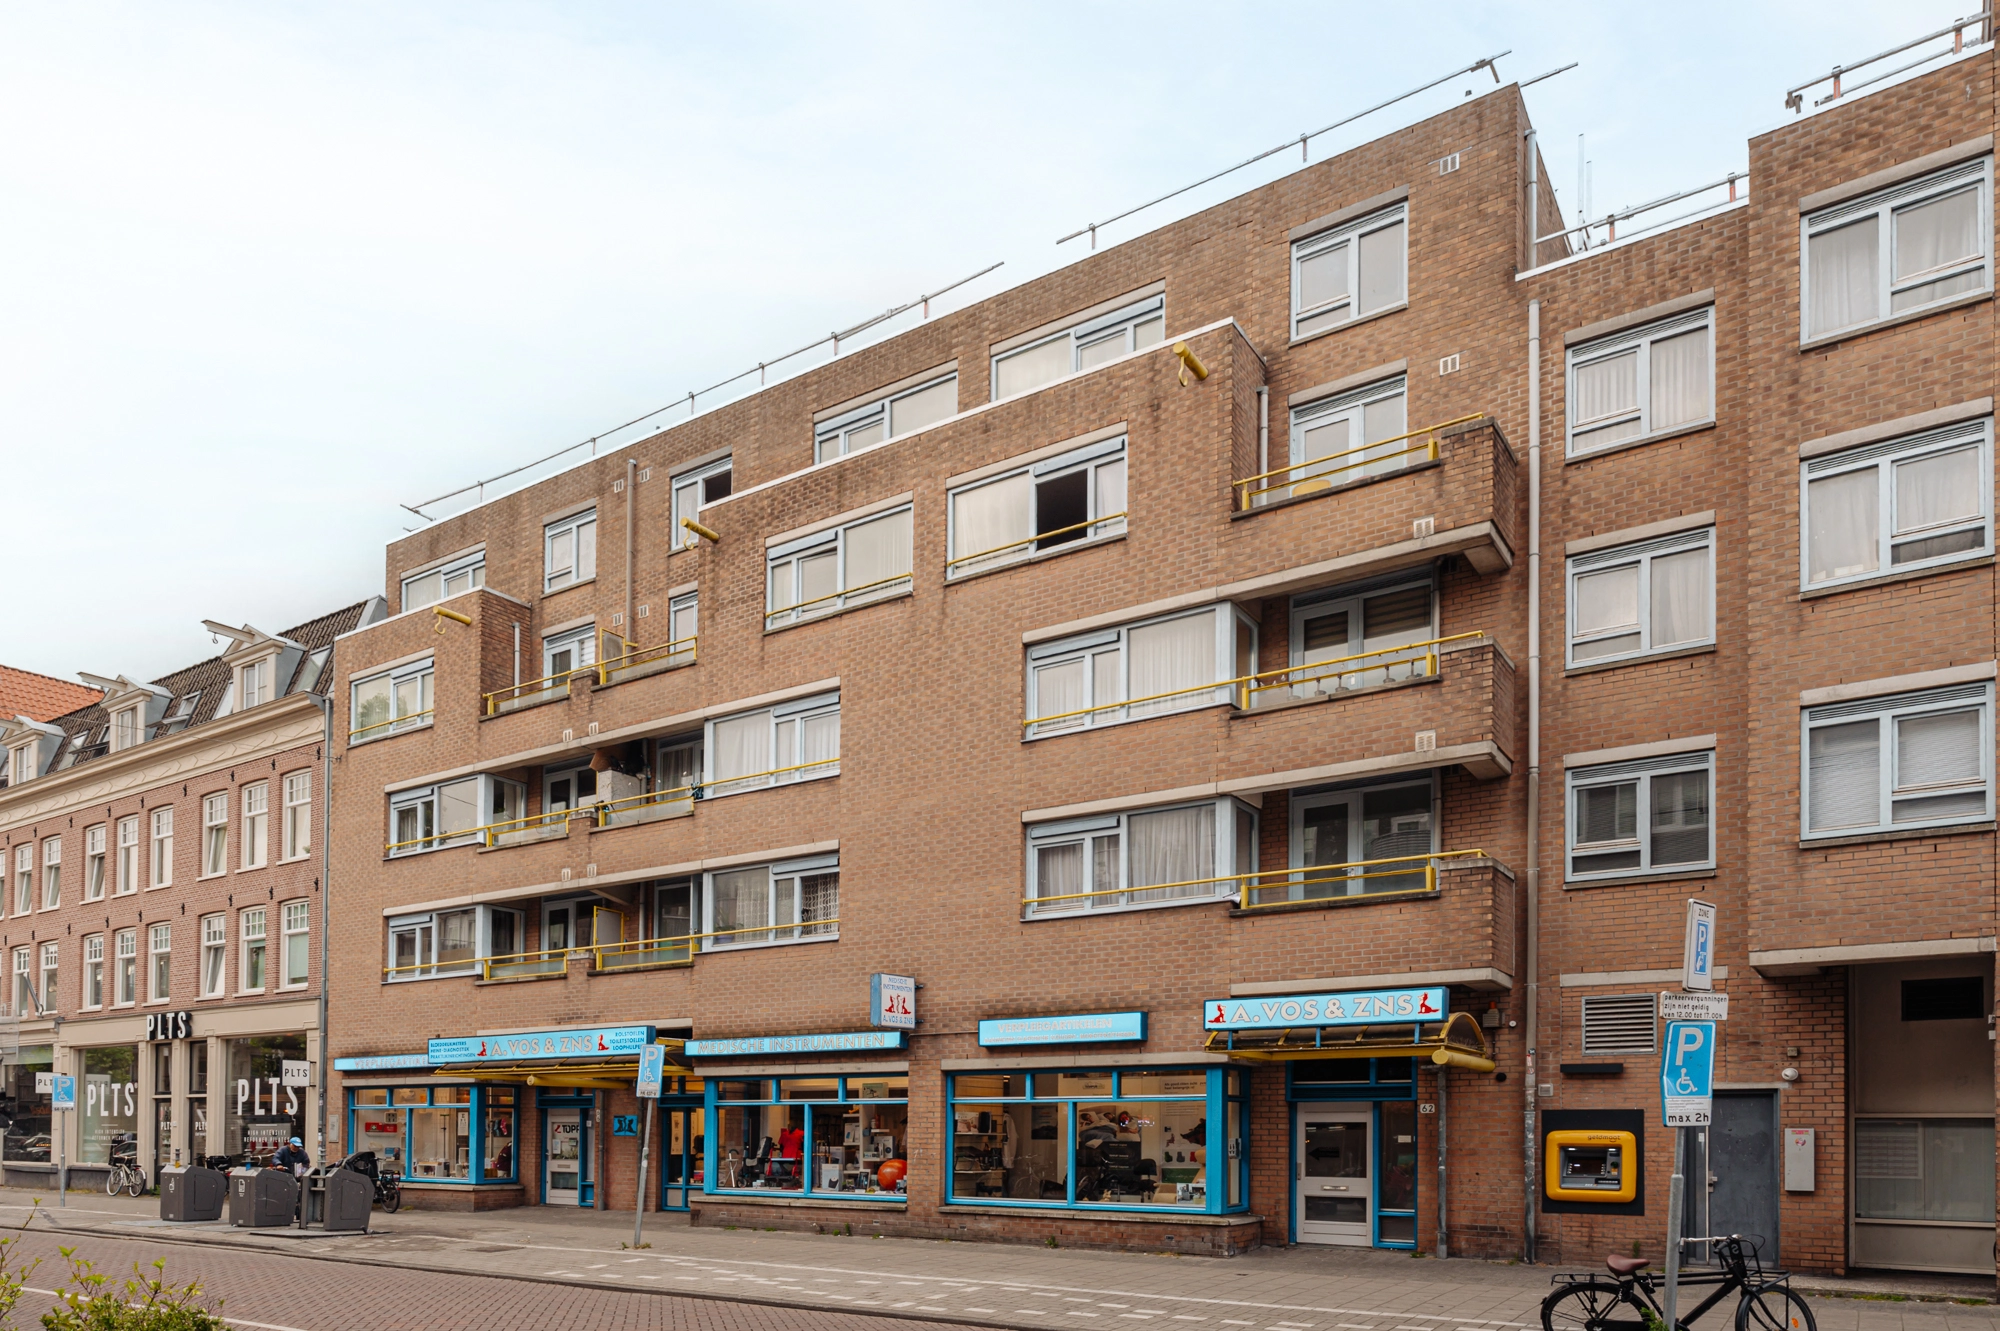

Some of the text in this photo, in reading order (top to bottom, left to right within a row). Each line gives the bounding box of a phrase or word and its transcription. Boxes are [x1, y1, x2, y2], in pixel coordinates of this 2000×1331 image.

[1698, 908, 1709, 918] ZONE
[888, 977, 907, 985] MEDISCHE
[883, 983, 912, 992] INSTRUMENTEN
[1664, 994, 1728, 1004] parkeervergunningen
[1323, 998, 1347, 1019] &
[1351, 994, 1413, 1018] ZNS
[1691, 1003, 1709, 1012] geldig
[1704, 1011, 1722, 1019] 17.00h
[146, 1011, 186, 1041] PLTS
[997, 1018, 1113, 1033] VERPLEEGARTIKELEN
[544, 1038, 556, 1053] &
[559, 1035, 593, 1053] ZNS
[697, 1033, 886, 1054] MEDISCHE INSTRUMENTEN
[284, 1068, 308, 1077] PLTS
[237, 1077, 298, 1115] PLTS
[1421, 1104, 1434, 1113] 62
[1668, 1112, 1709, 1123] max 2h
[161, 1122, 171, 1131] PLT
